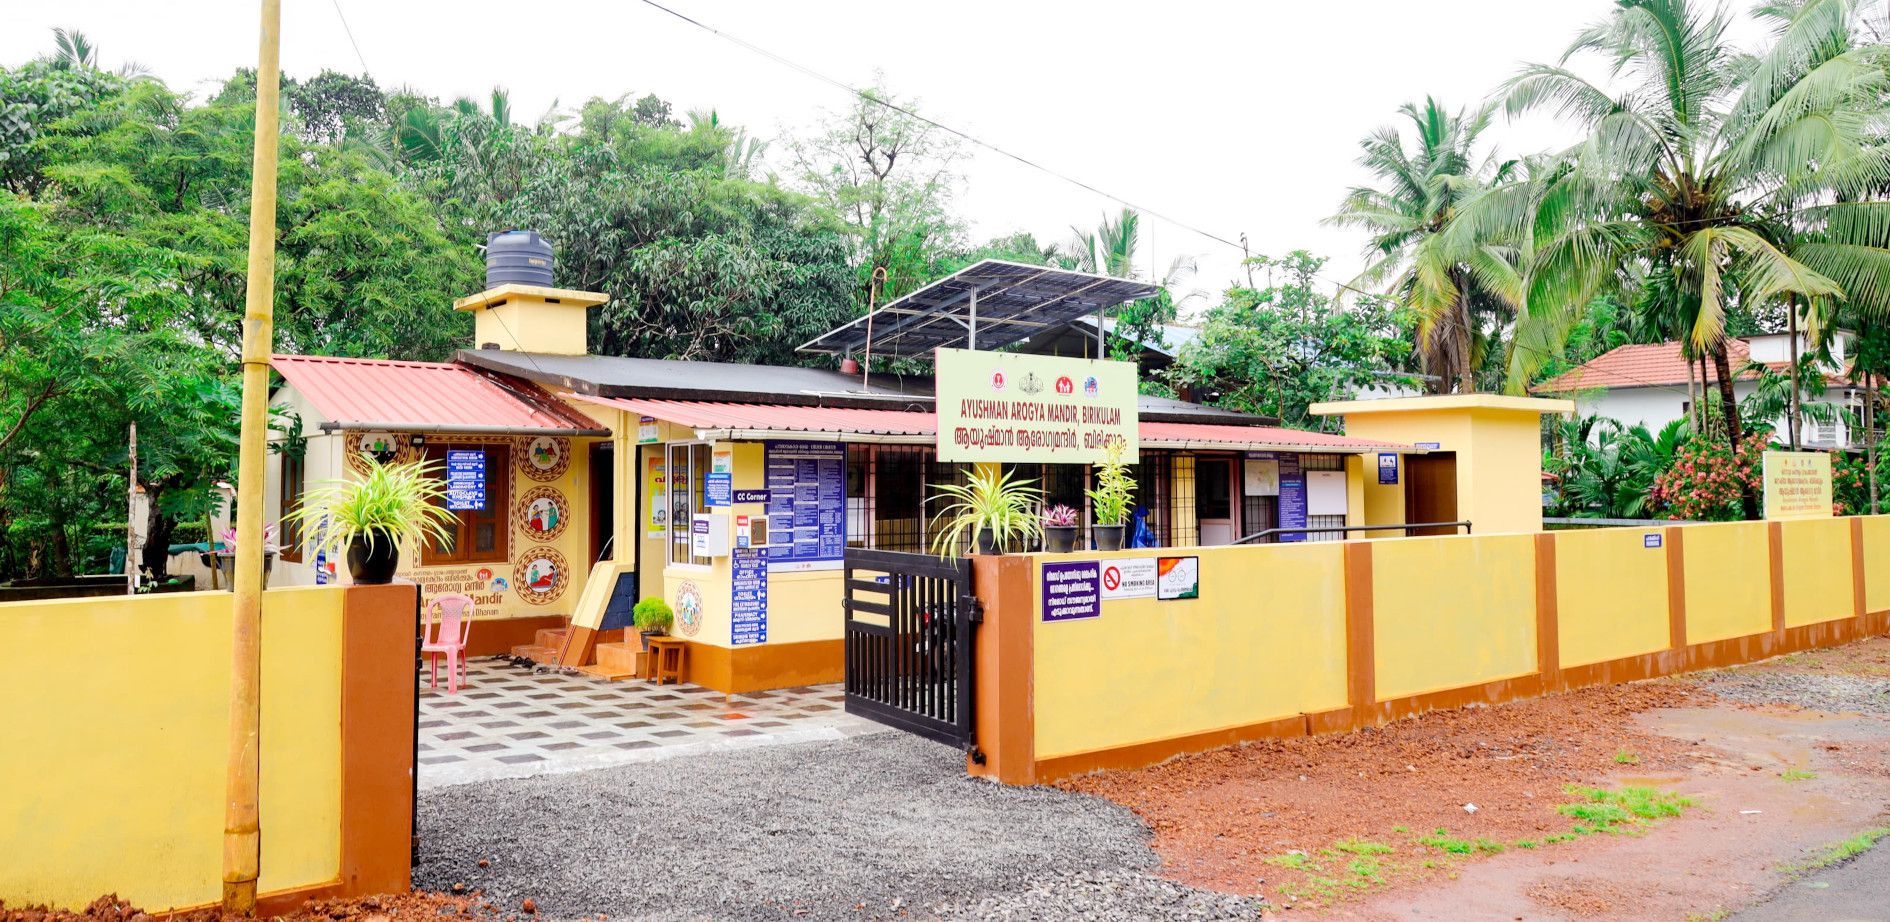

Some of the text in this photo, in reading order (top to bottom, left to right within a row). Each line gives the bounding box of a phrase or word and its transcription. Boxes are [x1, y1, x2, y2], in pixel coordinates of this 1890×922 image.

[961, 399, 1121, 426] AYUSHMAN AROGYA MANDIR, BIRIKULAM
[954, 425, 1014, 449] ആയുഷ്മാൻ
[737, 492, 768, 501] CC Corner
[425, 582, 462, 593] ആരോഗ്യ
